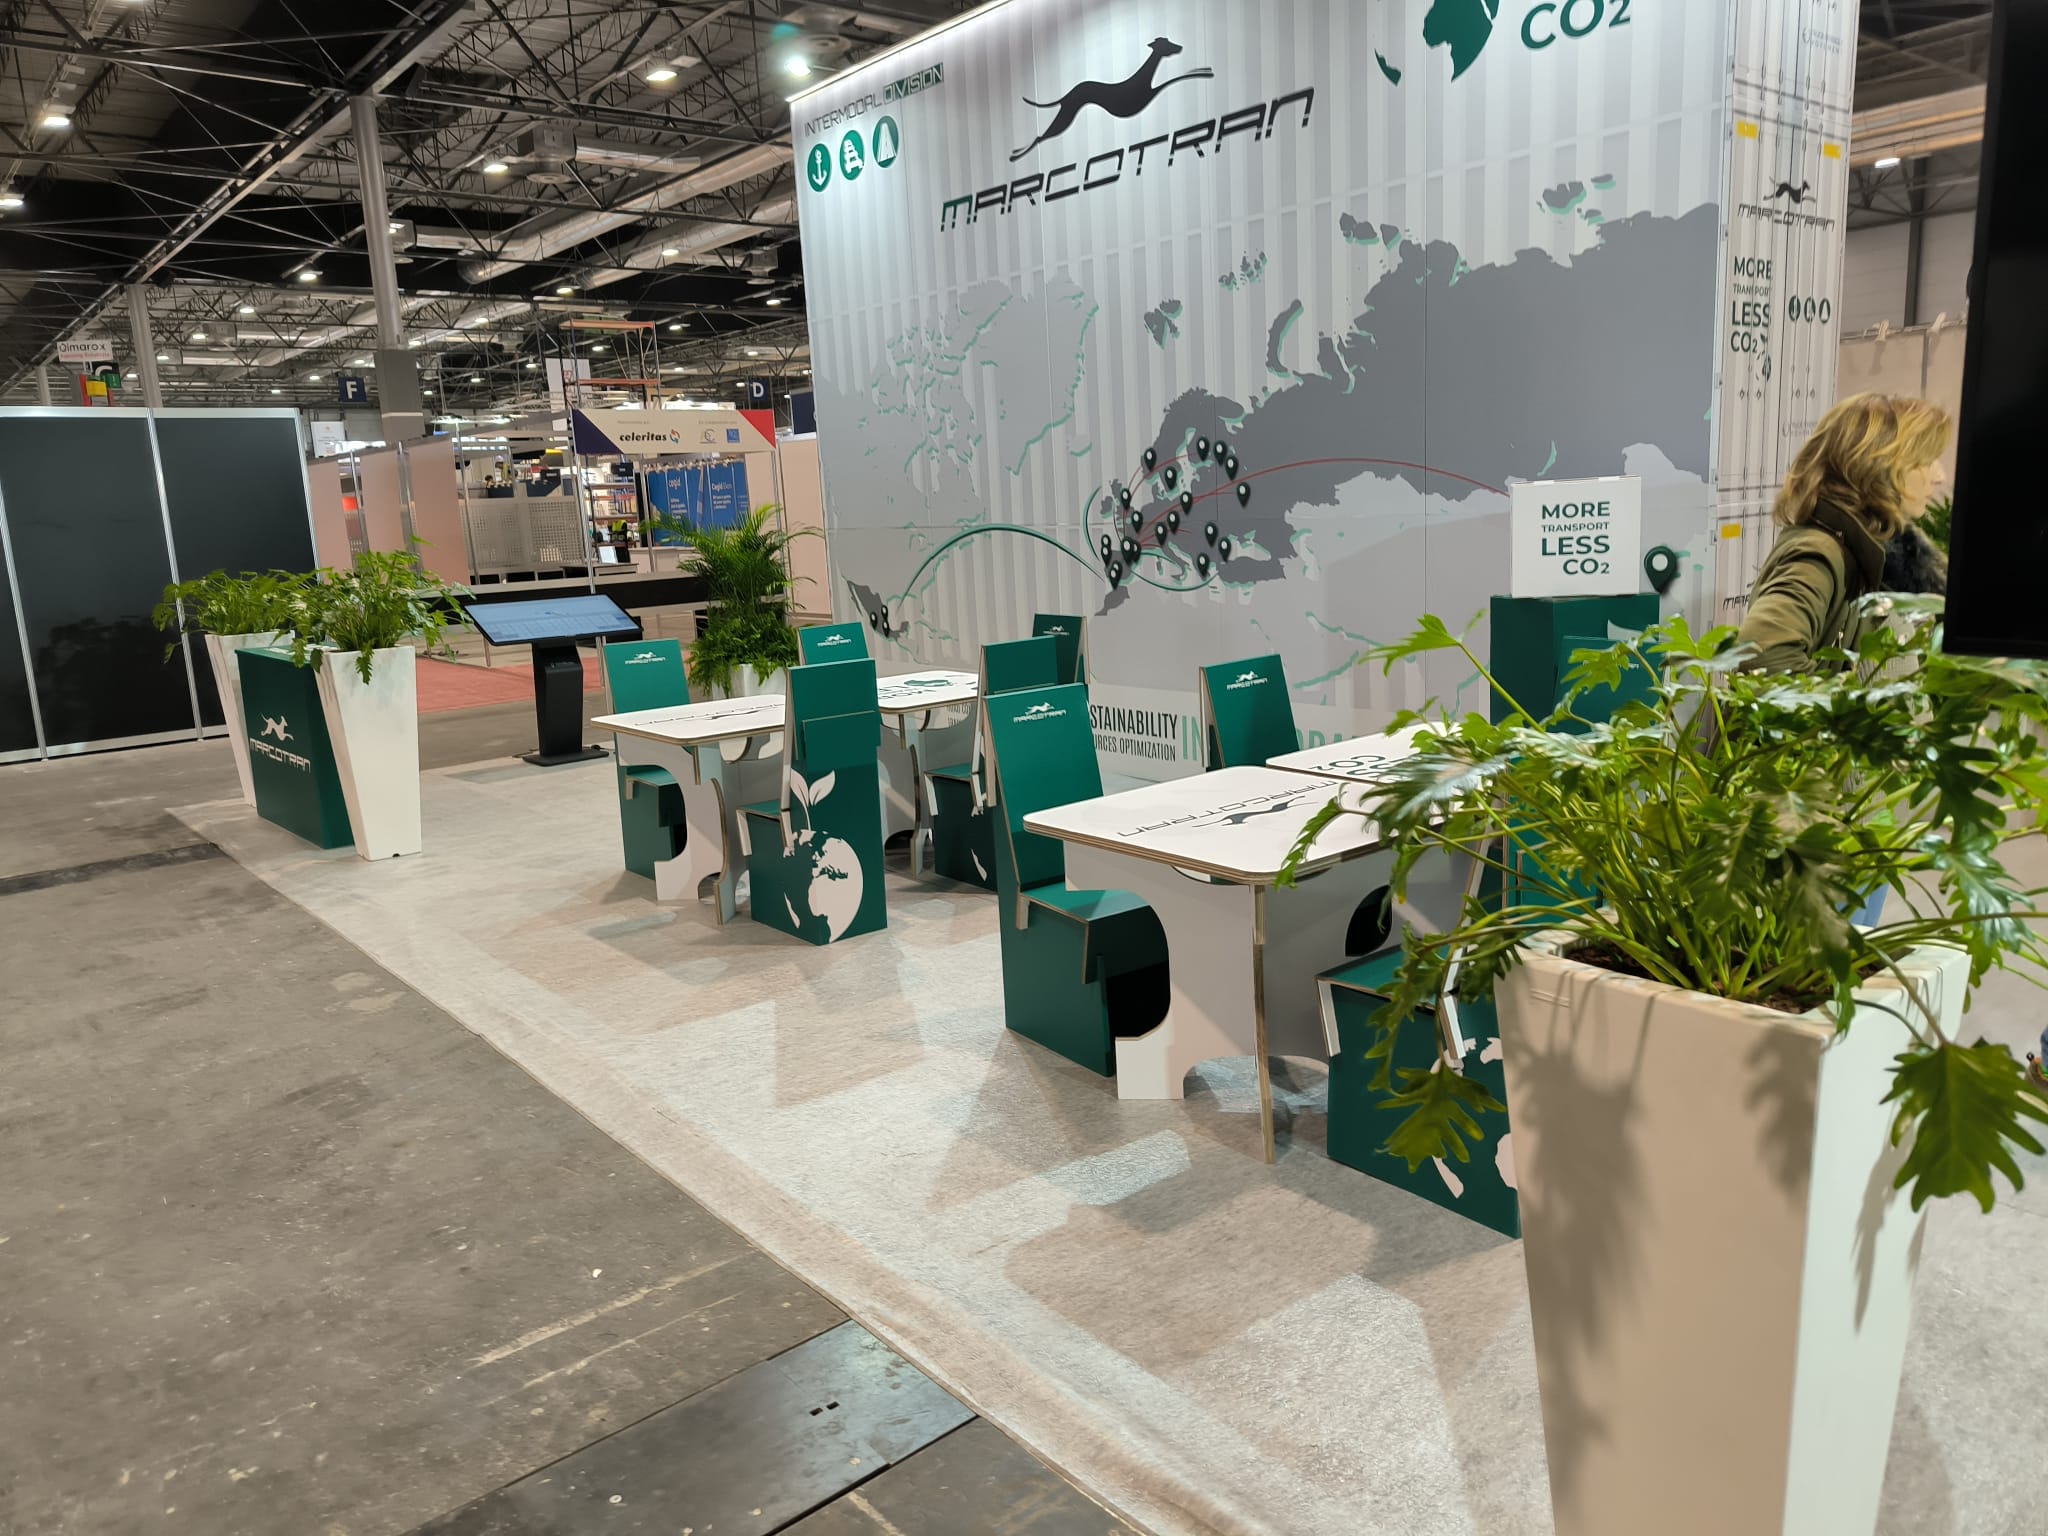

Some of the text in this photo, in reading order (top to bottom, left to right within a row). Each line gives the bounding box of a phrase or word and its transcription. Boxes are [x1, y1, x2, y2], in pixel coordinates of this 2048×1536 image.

[804, 62, 944, 137] INTERMODAL DIVISION
[941, 87, 1314, 232] MARCOTRAN
[1733, 283, 1771, 297] TRANPOR
[1731, 300, 1771, 328] LESS
[346, 381, 358, 399] F
[753, 381, 764, 398] D
[619, 431, 667, 442] celeritas
[1541, 501, 1610, 520] MORE
[1541, 522, 1610, 533] TRANSPORT
[1541, 535, 1610, 556] LESS
[1120, 737, 1176, 762] OPTIMIZATION
